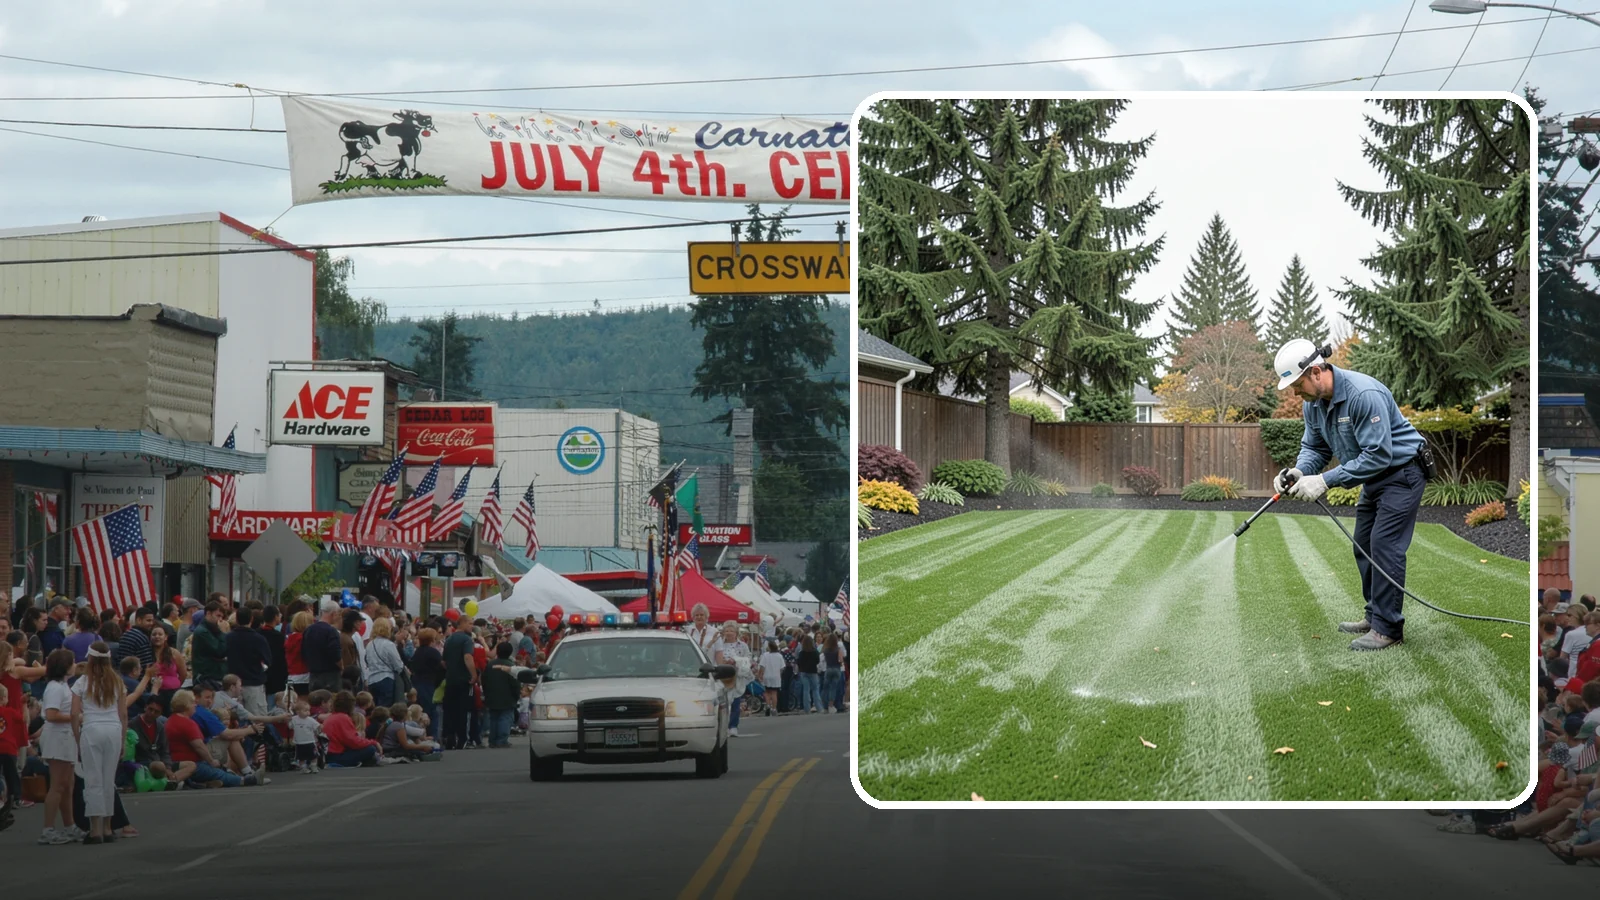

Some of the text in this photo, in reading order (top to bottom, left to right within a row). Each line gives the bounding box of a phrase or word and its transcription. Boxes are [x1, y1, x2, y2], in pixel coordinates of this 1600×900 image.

[481, 141, 605, 193] JULY
[632, 150, 746, 198] 4th.
[697, 254, 850, 280] CROSSWA
[283, 380, 374, 419] ACE
[406, 409, 485, 422] CEDAR LOG
[283, 420, 371, 437] Hardware
[416, 428, 477, 447] Coca-Cola
[353, 467, 385, 480] Simpl
[83, 484, 155, 495] St. Vincent de Paul
[688, 526, 741, 535] CRNATION
[699, 535, 730, 543] GLASS
